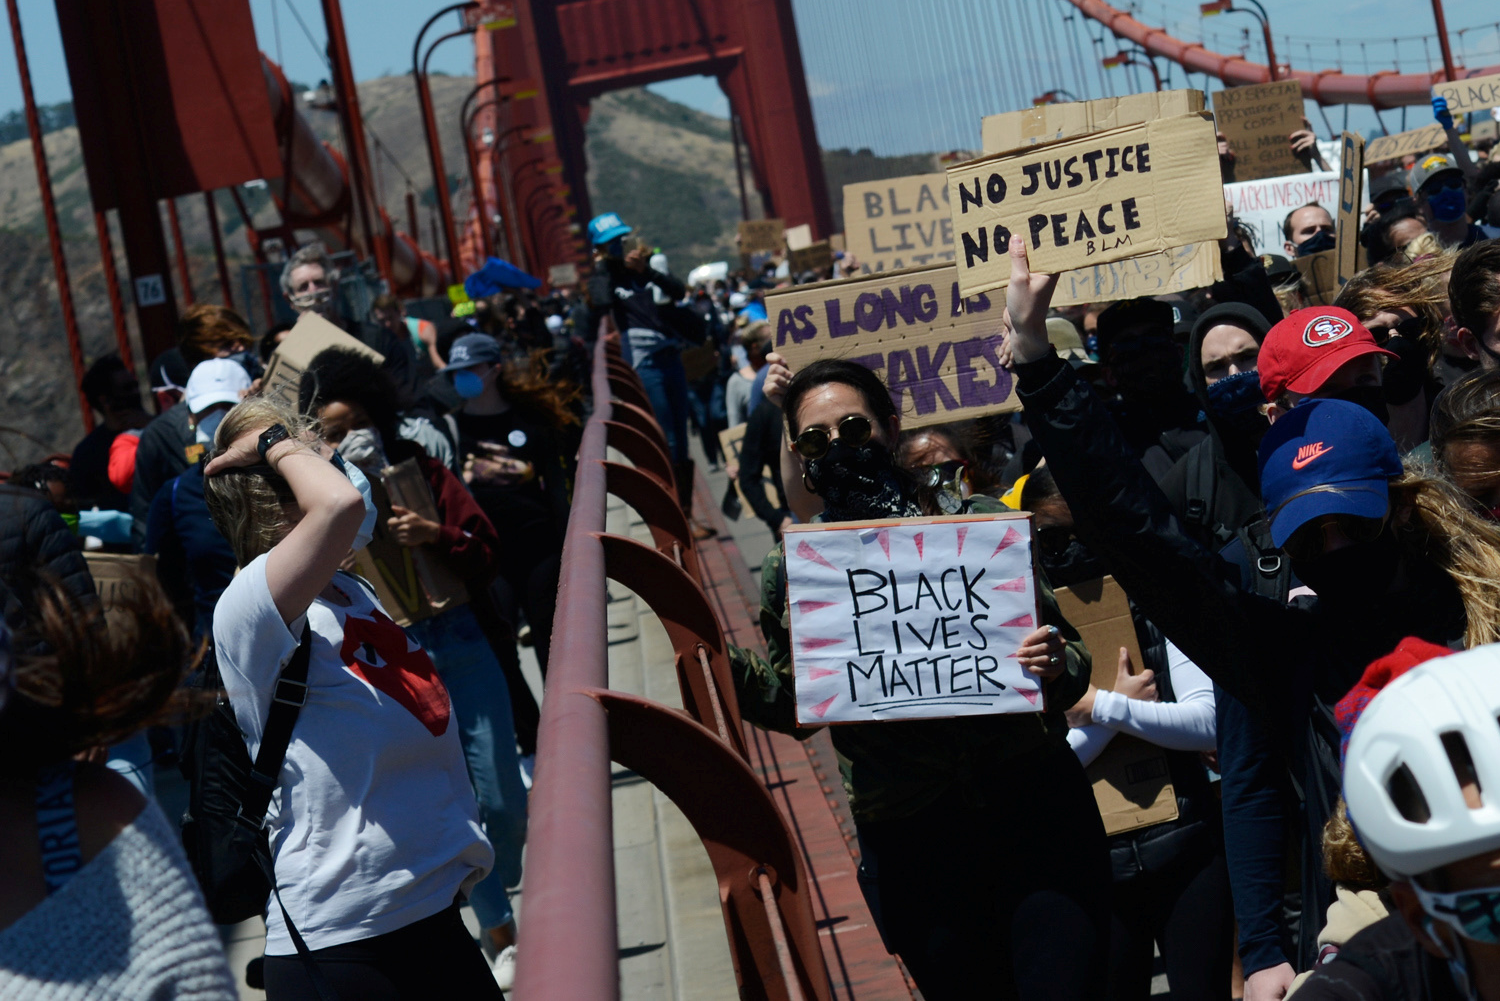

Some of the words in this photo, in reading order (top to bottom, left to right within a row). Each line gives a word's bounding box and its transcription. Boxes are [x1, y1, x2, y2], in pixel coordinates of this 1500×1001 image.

[1441, 81, 1500, 112] BLACK
[958, 172, 1008, 214] NO
[1021, 142, 1152, 196] JUSTICE
[961, 224, 1011, 269] NO
[1027, 197, 1141, 251] PEACE
[1086, 234, 1133, 257] BLM
[140, 281, 162, 301] 76
[775, 304, 818, 347] AS
[824, 283, 939, 339] LONG
[1297, 441, 1324, 461] NIKE
[846, 565, 990, 619] BLACK
[853, 614, 989, 657] LIVES
[846, 654, 1007, 703] MATTER
